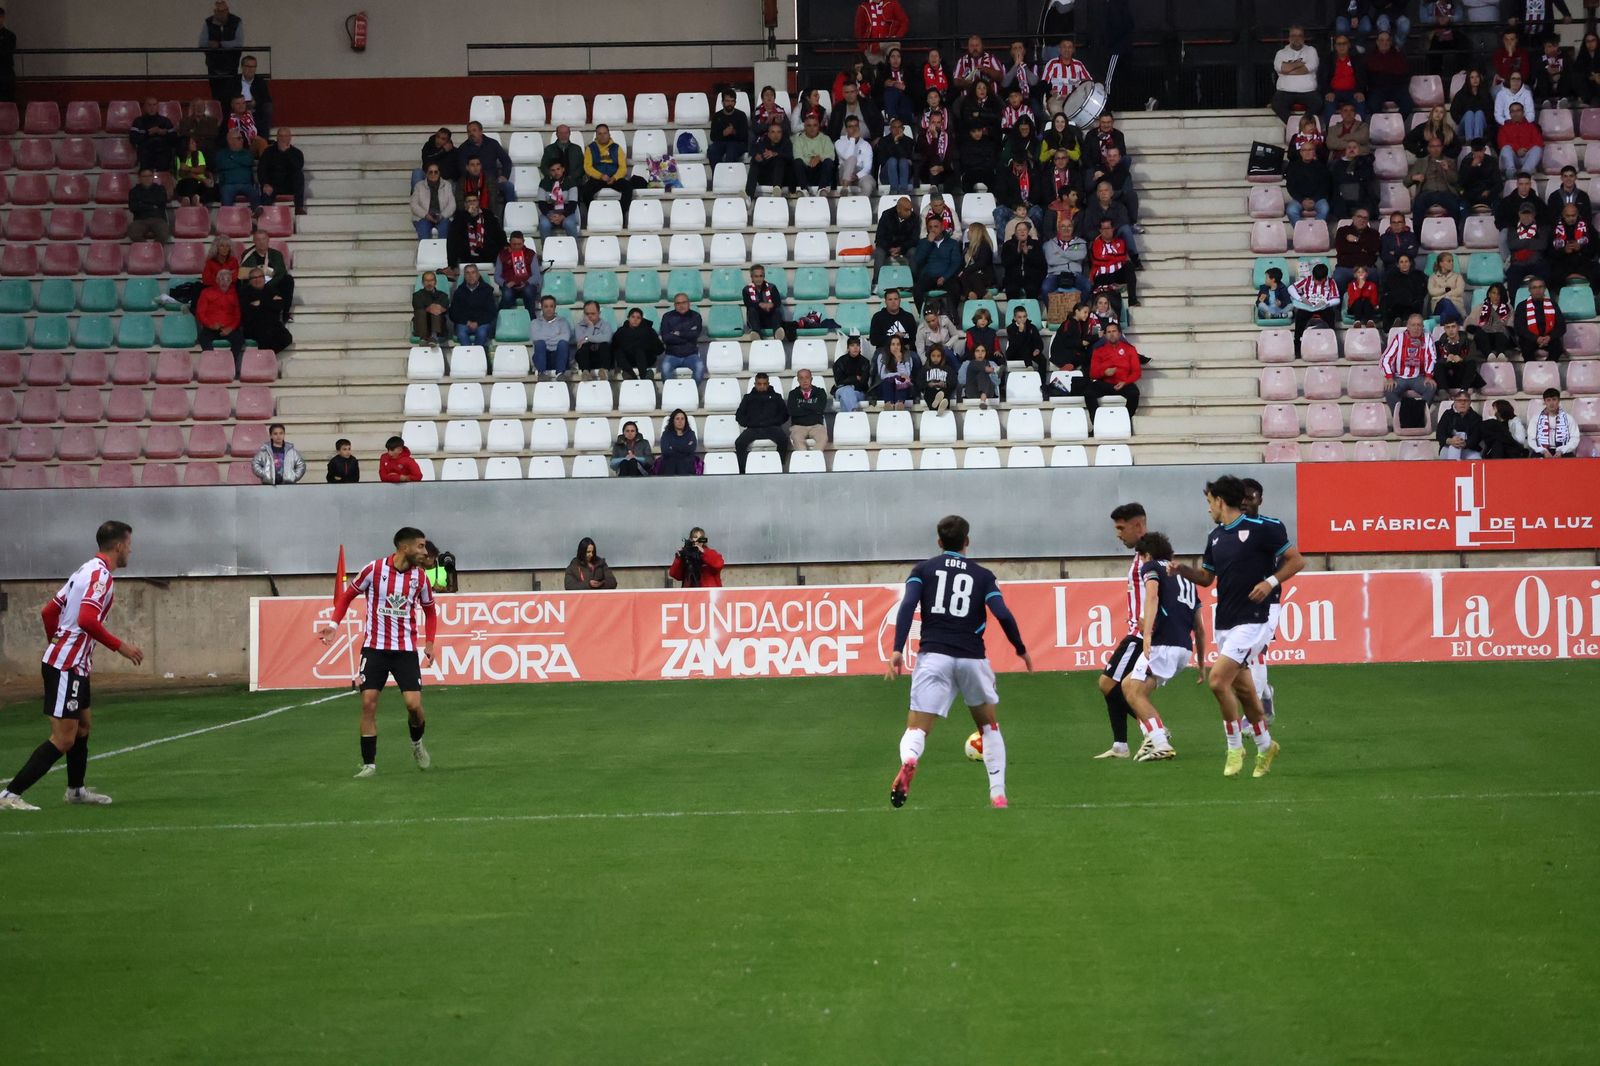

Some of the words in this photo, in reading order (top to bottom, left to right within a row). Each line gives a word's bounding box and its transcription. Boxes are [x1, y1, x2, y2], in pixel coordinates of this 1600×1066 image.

[1330, 519, 1356, 532] LA
[1362, 515, 1450, 531] FÁBRICA
[1489, 517, 1516, 529] DE
[1521, 517, 1548, 529] LA
[1554, 516, 1594, 529] LUZ
[944, 558, 968, 570] EDER
[930, 569, 974, 617] 18
[1430, 574, 1495, 639] La
[661, 592, 864, 635] FUNDACIÓN
[1053, 585, 1117, 648] La
[1074, 650, 1096, 666] El
[1450, 640, 1473, 657] El
[1477, 641, 1553, 657] Correo
[1572, 638, 1599, 656] de
[415, 643, 581, 682] AMORA
[71, 680, 80, 698] 9
